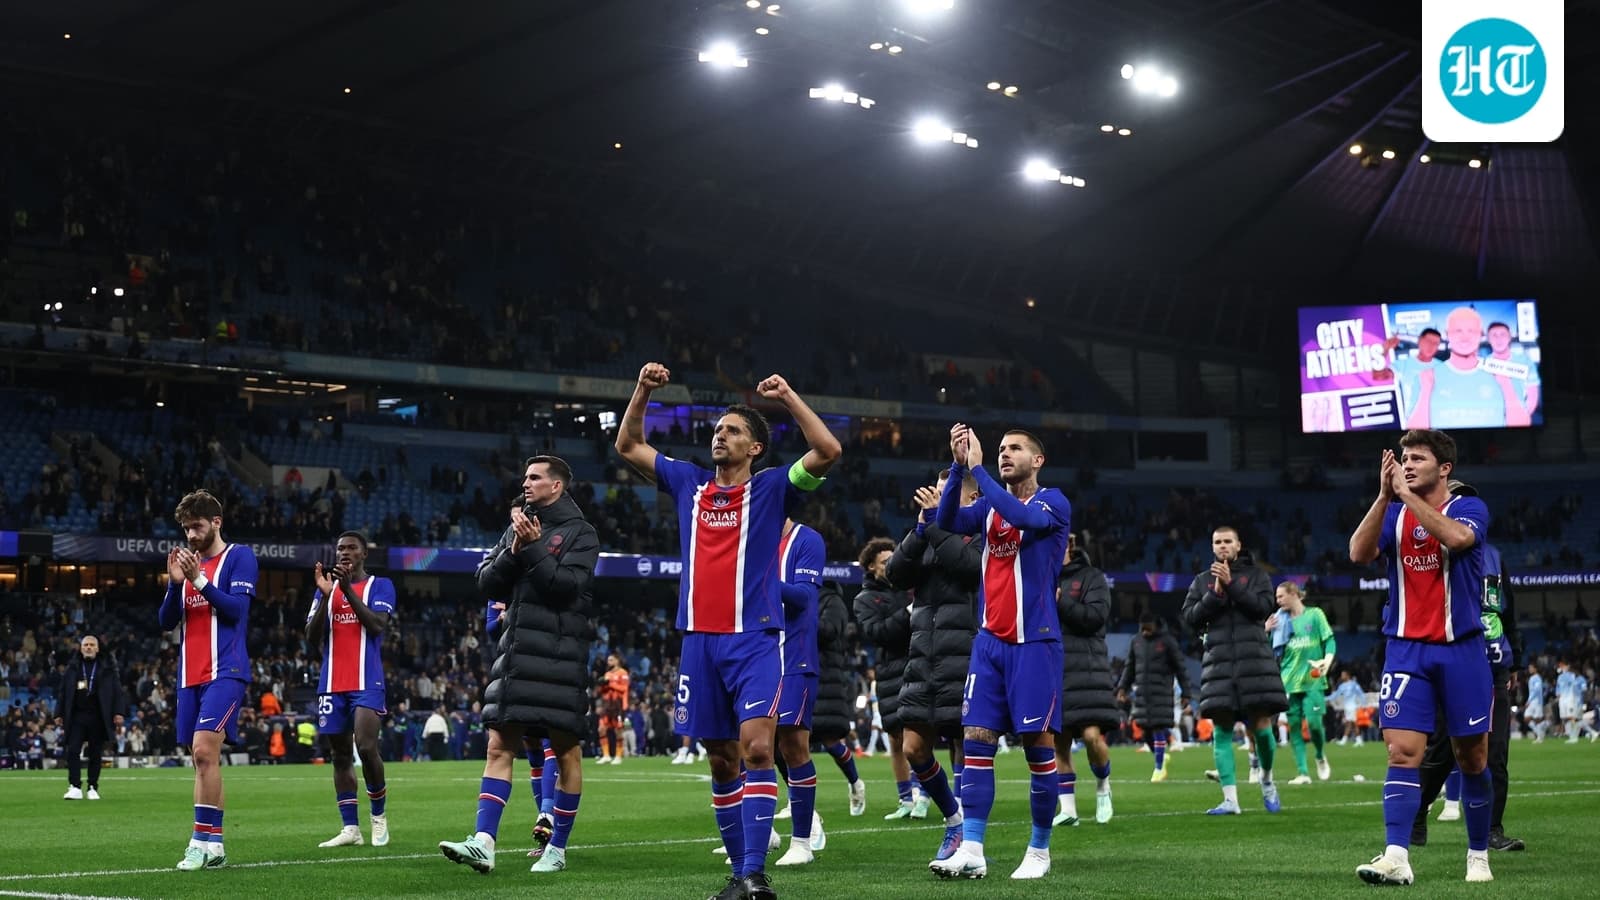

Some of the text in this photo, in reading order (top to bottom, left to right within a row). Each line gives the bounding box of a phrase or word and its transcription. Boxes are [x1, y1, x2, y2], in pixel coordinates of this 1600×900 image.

[1316, 318, 1364, 350] CITY
[1306, 343, 1386, 379] ATHENS
[700, 511, 738, 523] QATAR
[116, 539, 154, 553] UEFA
[252, 544, 296, 559] EAGUE
[989, 540, 1018, 554] QATAR
[1403, 553, 1439, 566] QATAR
[660, 561, 683, 573] PEP
[795, 568, 820, 577] BEYOND
[822, 566, 851, 578] RWAYS
[1413, 563, 1440, 572] AIRWAYS
[1359, 577, 1390, 590] bet3
[1522, 574, 1582, 586] CHAMPIONS
[186, 594, 207, 606] QATA
[1486, 643, 1503, 663] 3
[678, 674, 690, 704] 5
[1380, 673, 1411, 700] 87
